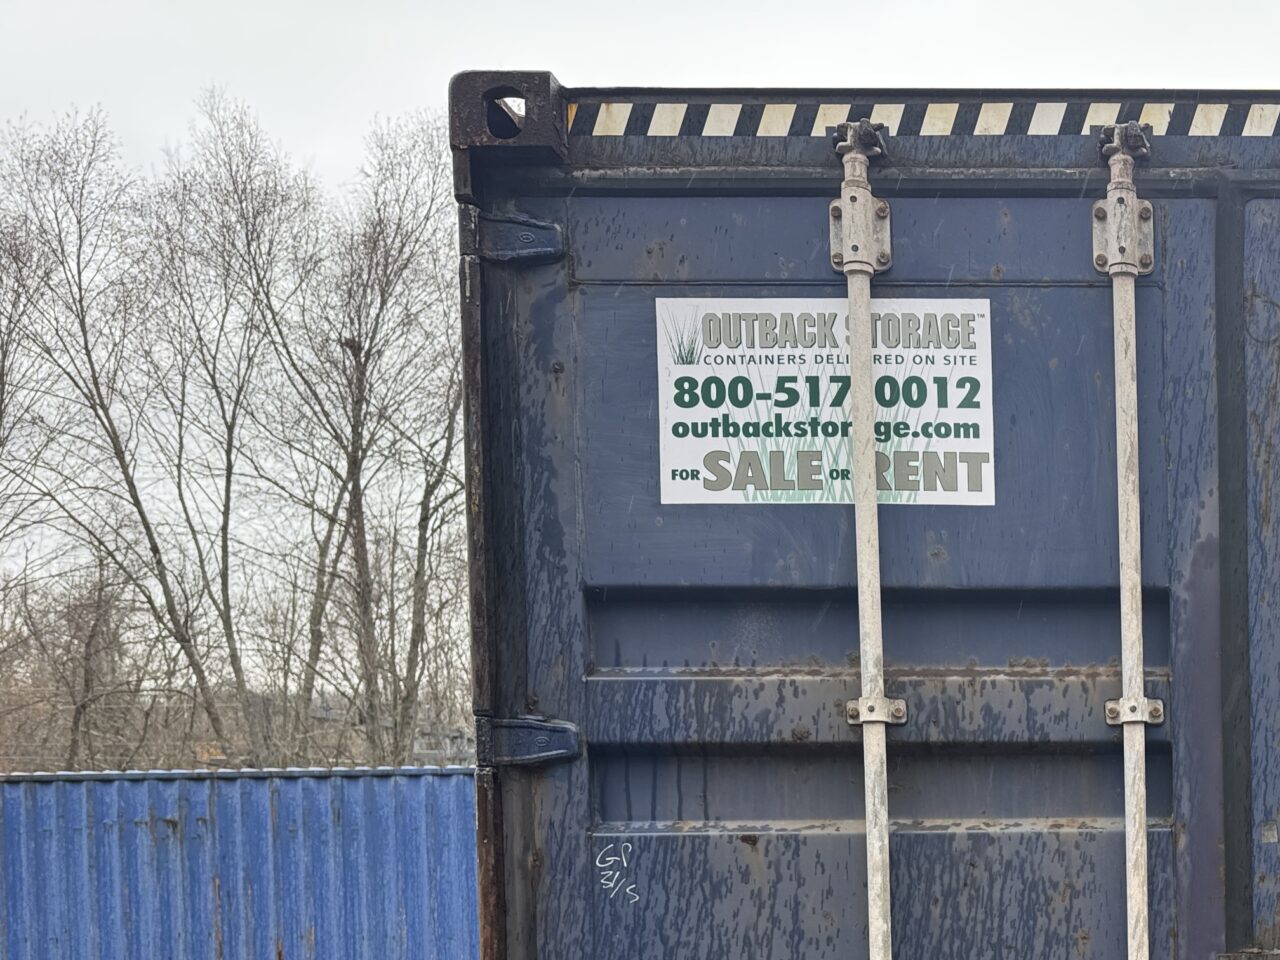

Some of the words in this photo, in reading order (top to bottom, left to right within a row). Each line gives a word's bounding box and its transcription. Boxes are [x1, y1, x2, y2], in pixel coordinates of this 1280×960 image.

[702, 312, 839, 349] OUTBACK
[845, 312, 977, 350] TORAGE
[704, 354, 806, 366] CONTAINERS
[814, 354, 905, 366] DELIRED
[913, 354, 935, 366] ON
[943, 354, 977, 366] SITE
[671, 414, 980, 442] outbackstorge.com
[671, 469, 700, 480] FOR
[703, 450, 823, 491] SALE
[829, 468, 851, 481] OR
